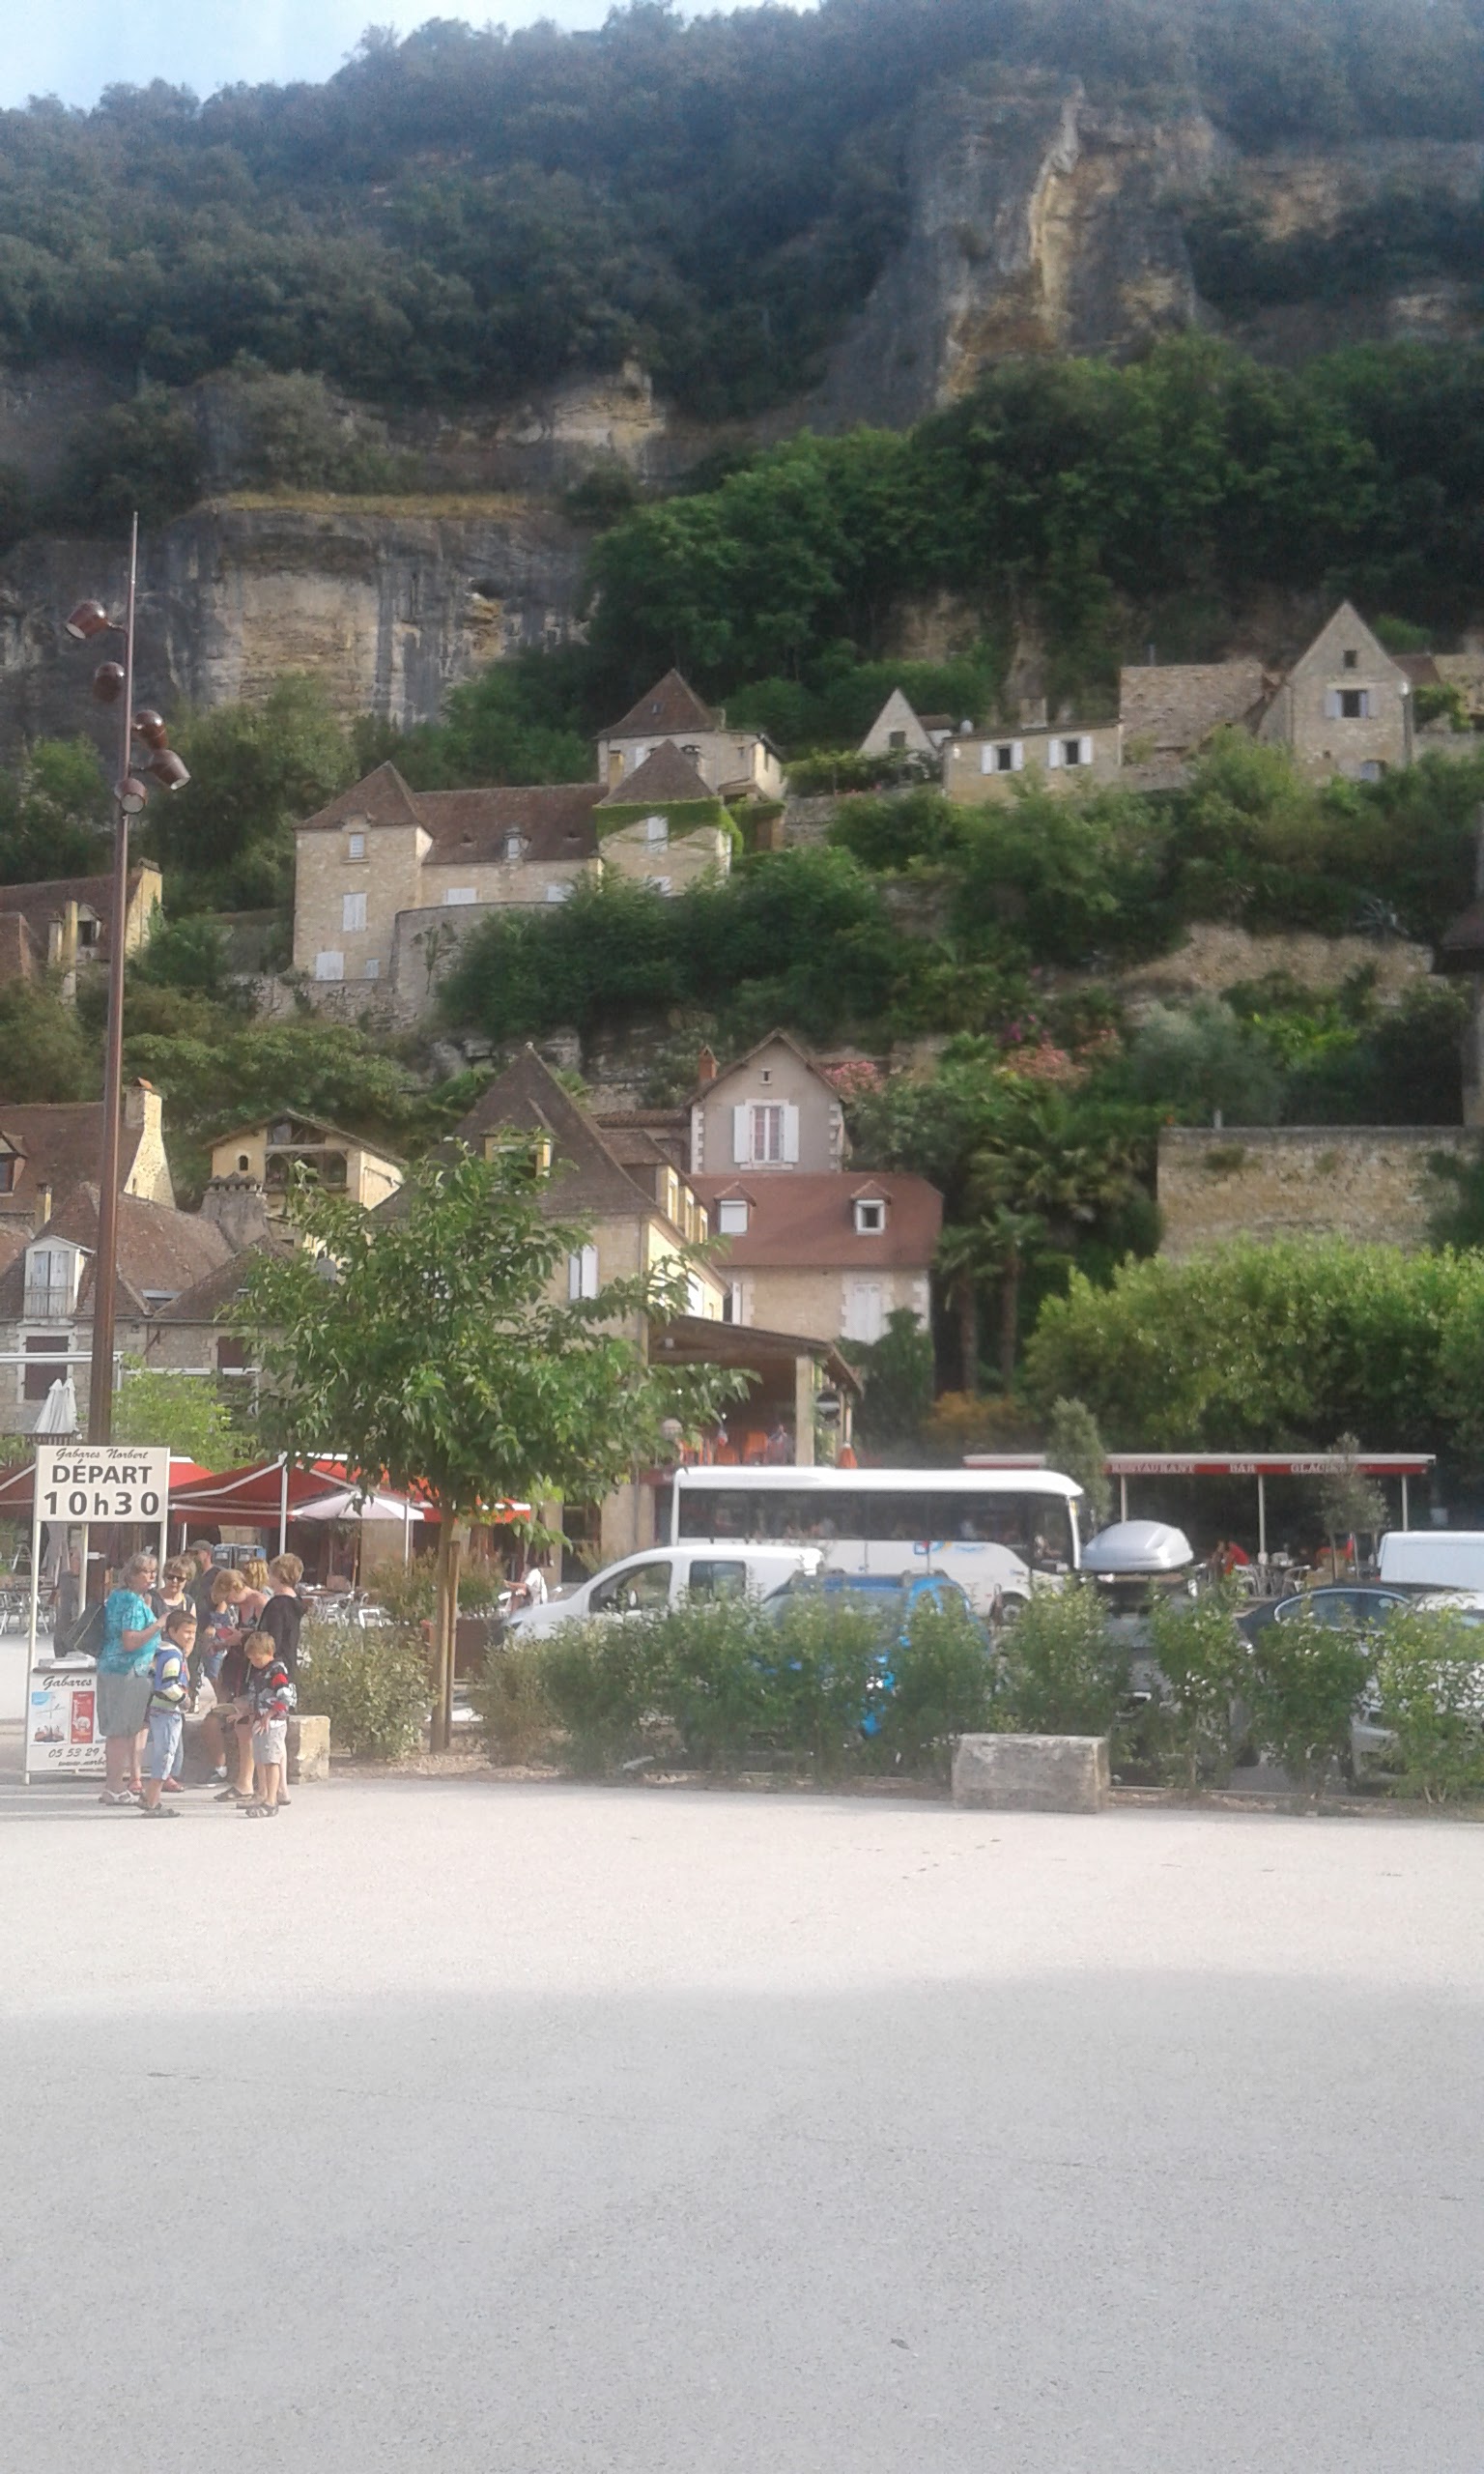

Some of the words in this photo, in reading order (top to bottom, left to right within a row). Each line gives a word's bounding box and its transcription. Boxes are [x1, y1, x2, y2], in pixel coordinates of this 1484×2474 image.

[56, 1448, 100, 1460] Gabares
[106, 1449, 149, 1459] Norbert
[51, 1458, 153, 1483] DÉPART
[1229, 1462, 1256, 1474] BAR
[43, 1491, 159, 1515] 10h30
[43, 1675, 93, 1690] Gabares
[48, 1748, 64, 1758] 05
[66, 1747, 82, 1757] 53
[84, 1747, 100, 1756] 29
